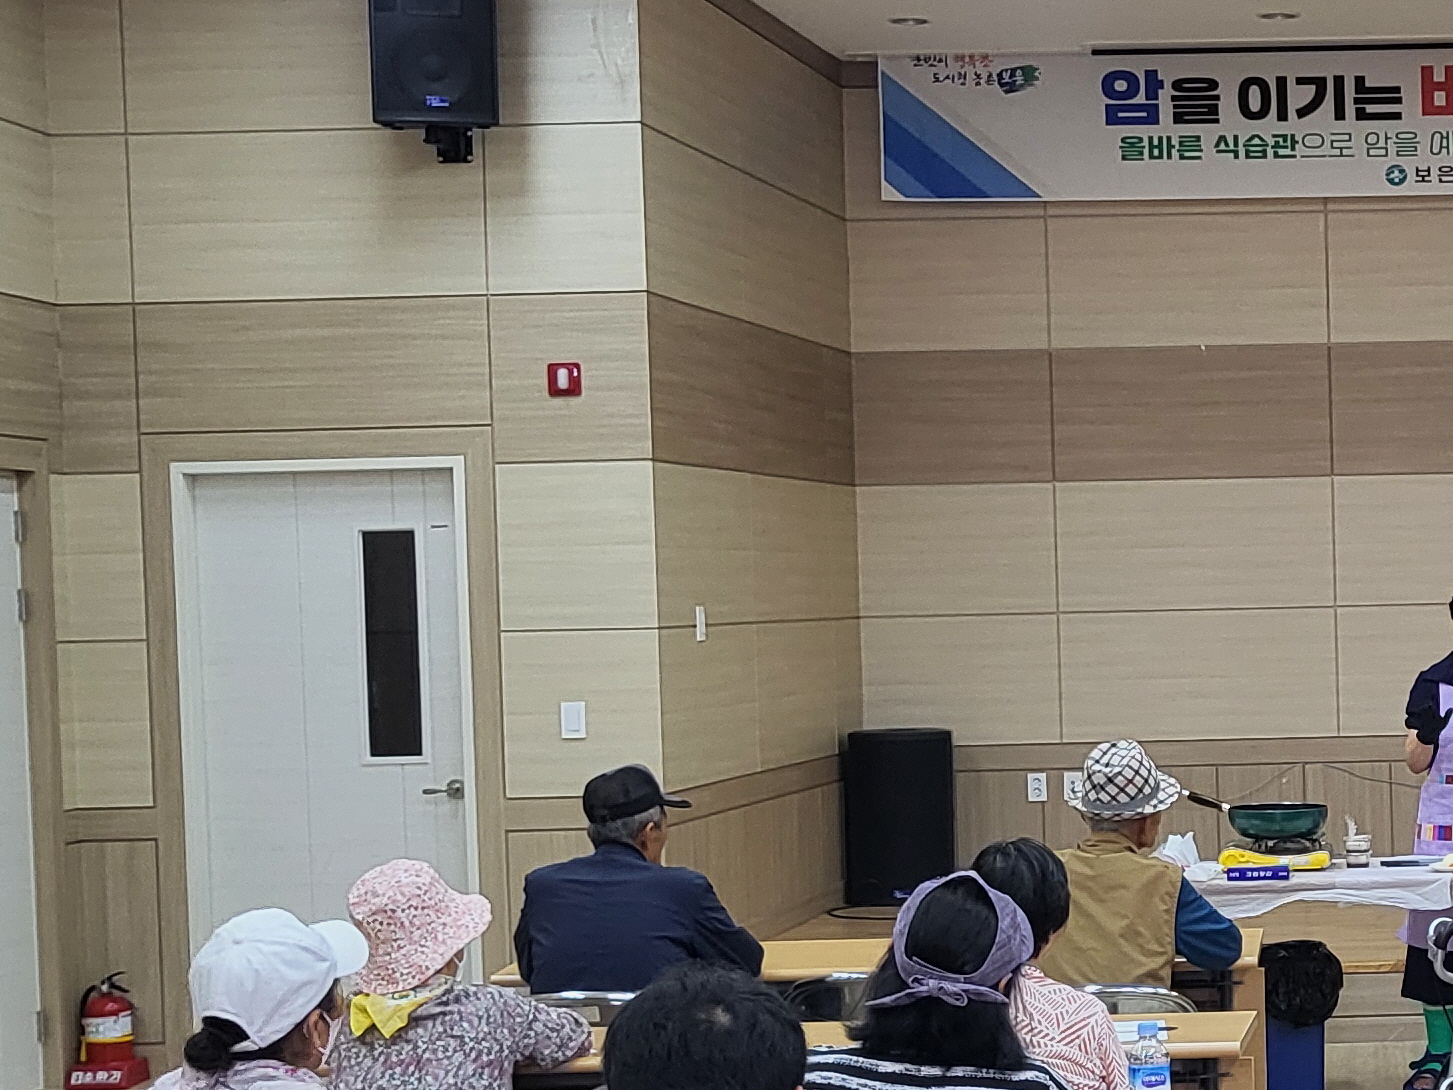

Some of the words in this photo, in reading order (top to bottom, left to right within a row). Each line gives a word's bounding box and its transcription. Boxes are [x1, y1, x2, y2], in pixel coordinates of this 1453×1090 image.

[1101, 69, 1221, 126] 암을
[1237, 74, 1403, 122] 이기는
[1119, 134, 1204, 161] 올바른
[1214, 132, 1355, 160] 식습관으로
[1364, 130, 1420, 158] 암을
